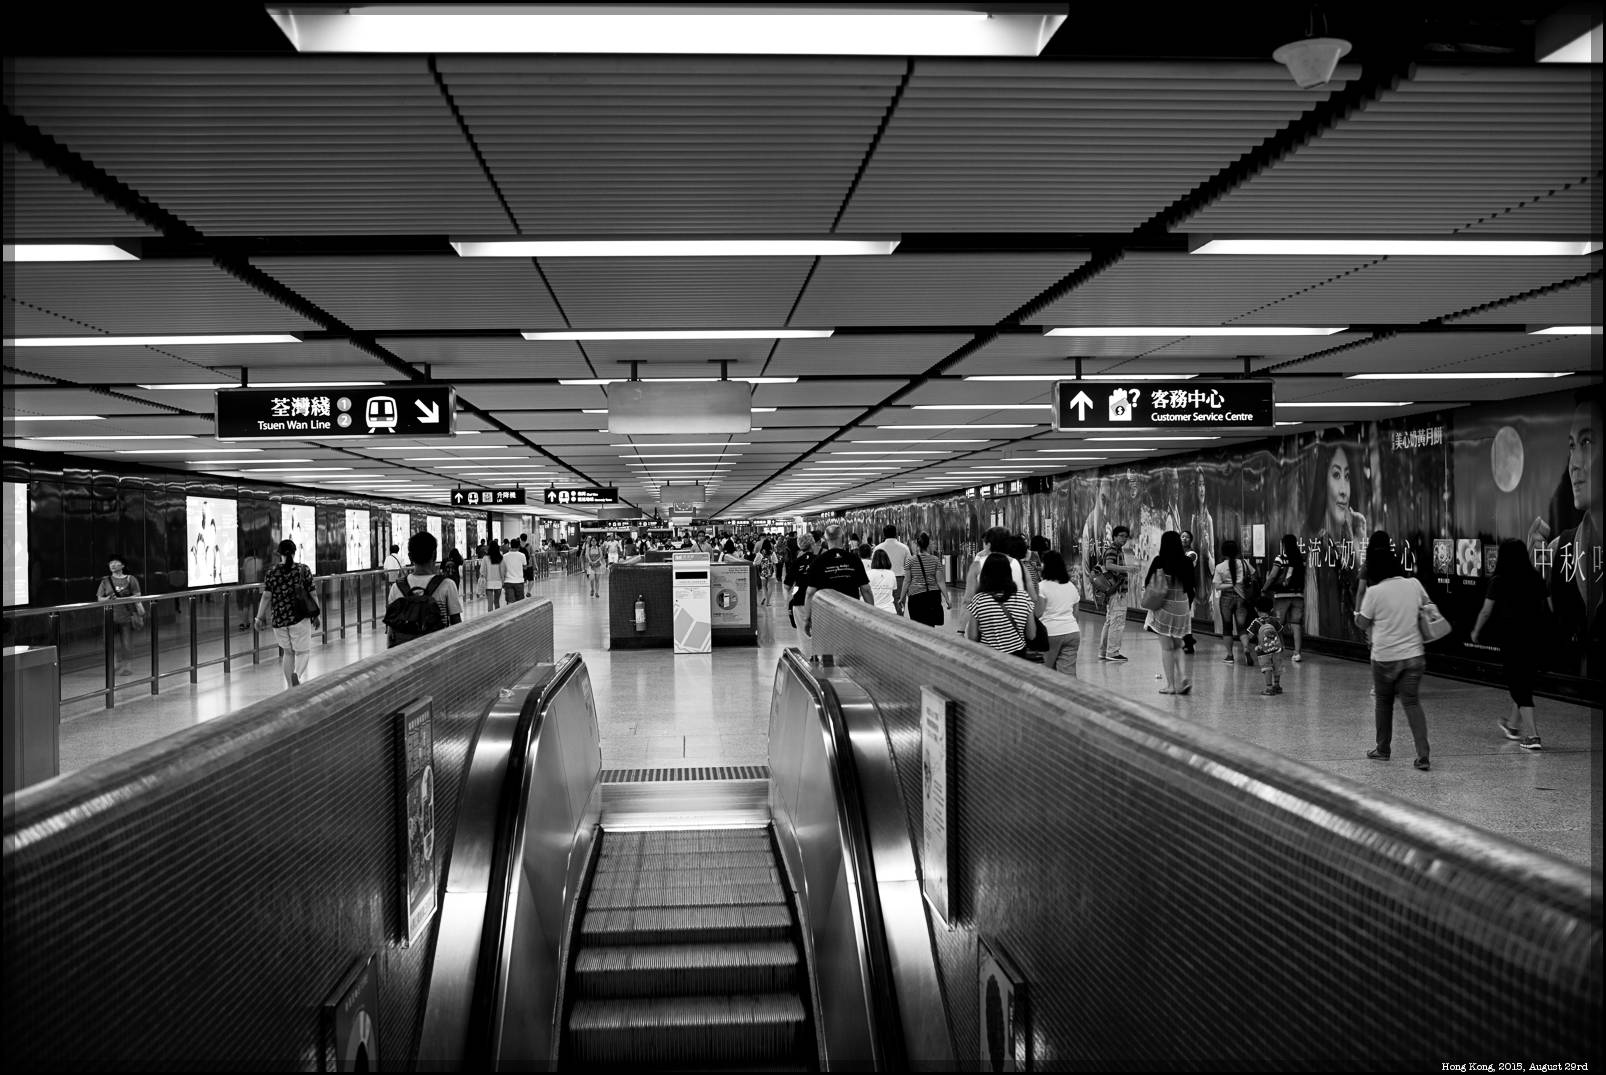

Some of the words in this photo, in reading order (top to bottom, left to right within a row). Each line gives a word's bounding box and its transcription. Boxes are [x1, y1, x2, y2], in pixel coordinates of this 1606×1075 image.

[1151, 389, 1225, 409] 客務中心
[1151, 412, 1191, 422] Customer
[1193, 412, 1223, 421] Service
[1225, 411, 1253, 421] Centre
[258, 420, 285, 431] Tsuen
[286, 420, 308, 430] Wan
[310, 420, 331, 430] Line
